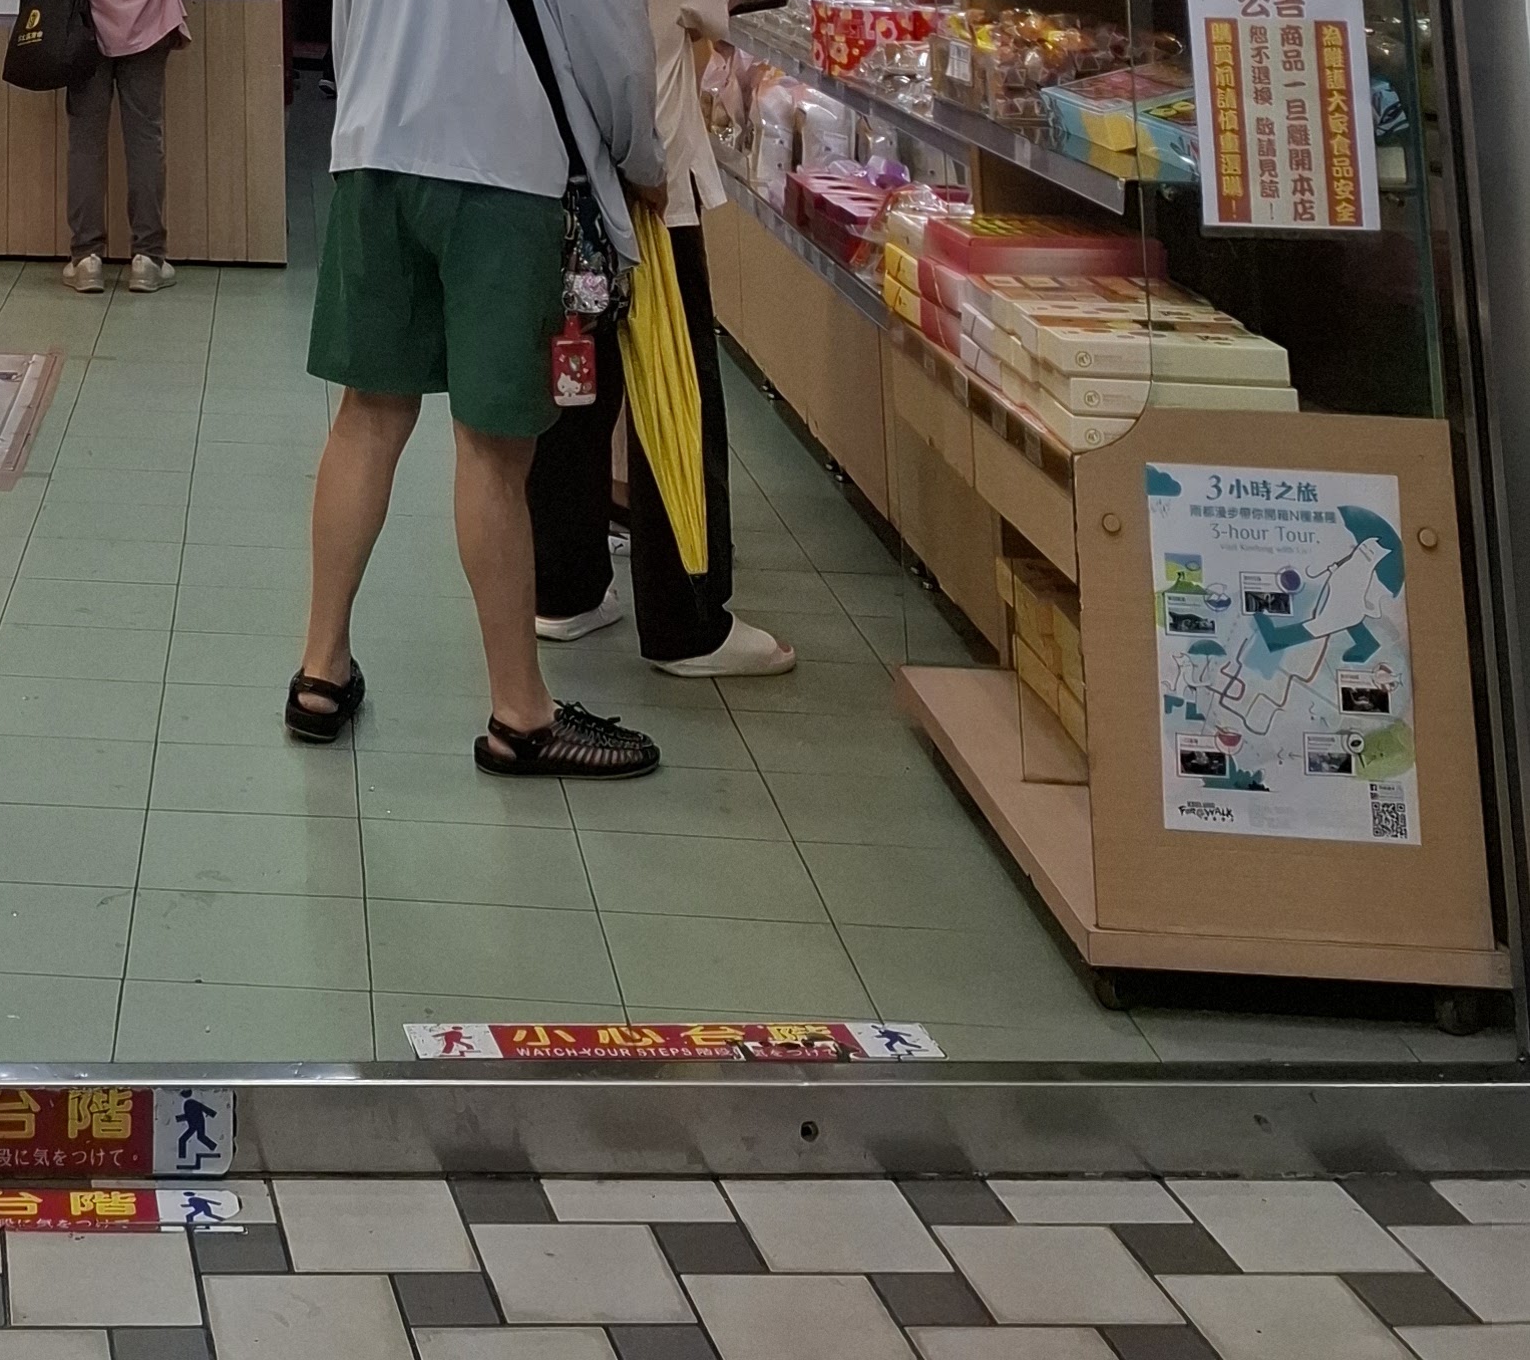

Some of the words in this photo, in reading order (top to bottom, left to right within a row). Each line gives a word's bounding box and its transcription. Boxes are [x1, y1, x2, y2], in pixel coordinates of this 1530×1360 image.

[1280, 24, 1316, 222] 商品一旦離開本店
[1209, 523, 1269, 541] 3-hour
[1275, 526, 1321, 544] Tour.
[513, 1025, 833, 1046] 小心台階
[516, 1047, 577, 1057] WATCH
[579, 1047, 630, 1057] YOUR
[637, 1048, 692, 1057] STEPS
